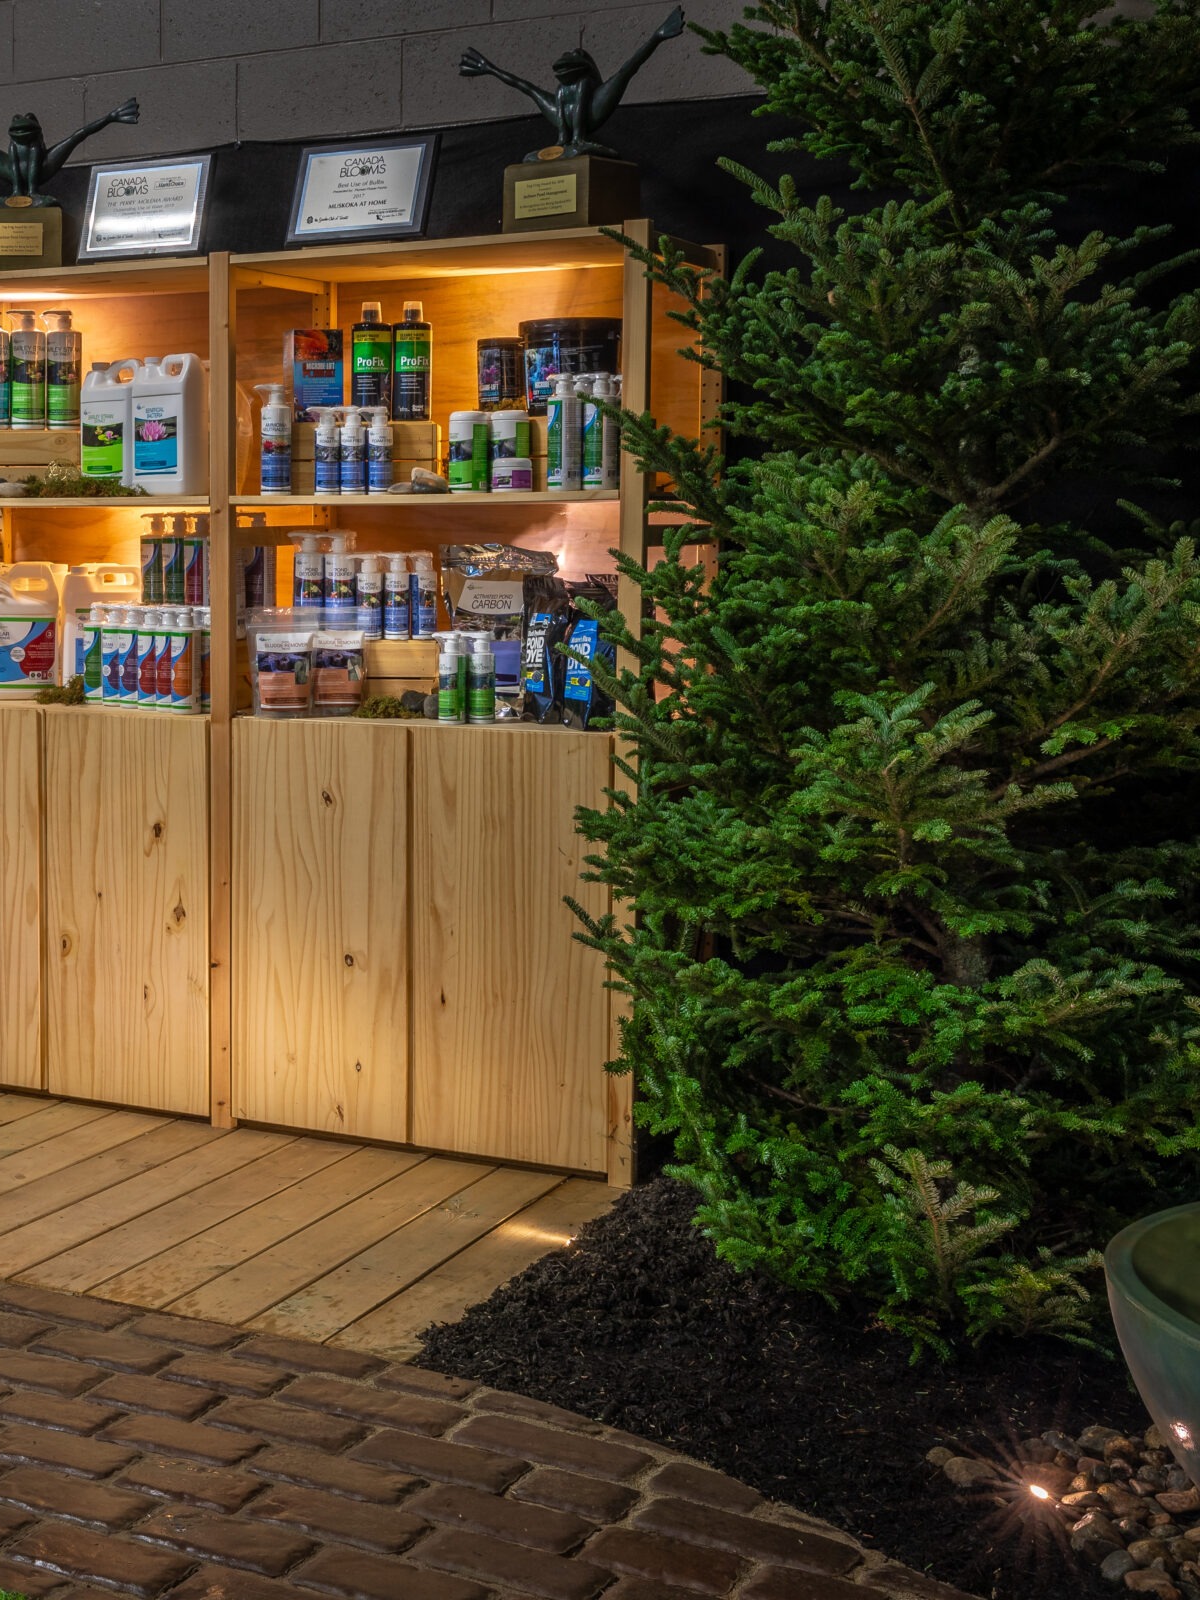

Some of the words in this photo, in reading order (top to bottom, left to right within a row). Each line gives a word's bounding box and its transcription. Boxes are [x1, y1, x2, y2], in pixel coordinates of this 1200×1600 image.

[344, 156, 384, 166] CANADA
[340, 164, 386, 178] BLOOMS
[111, 176, 148, 187] CANADA
[107, 185, 148, 198] BLOOMS
[357, 357, 384, 367] ProFix
[401, 356, 429, 366] ProFix
[472, 600, 512, 609] CARBON
[526, 637, 544, 650] POND
[526, 649, 543, 663] DYE
